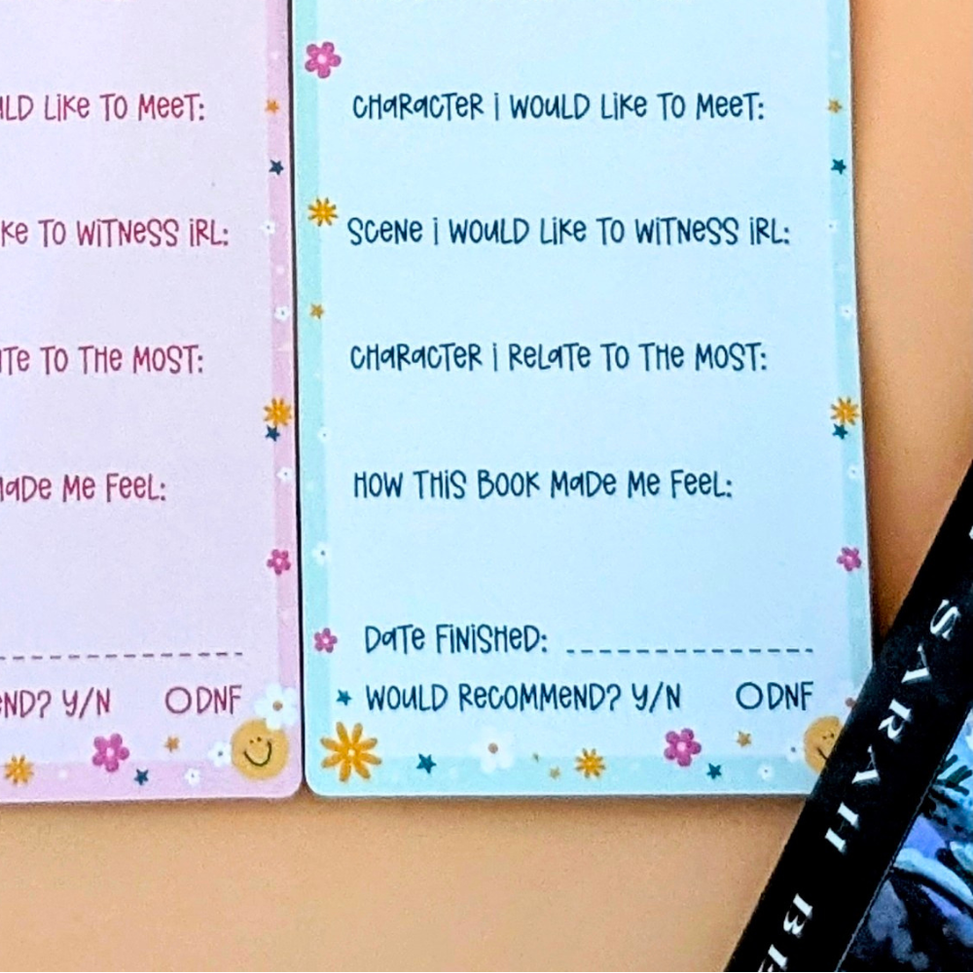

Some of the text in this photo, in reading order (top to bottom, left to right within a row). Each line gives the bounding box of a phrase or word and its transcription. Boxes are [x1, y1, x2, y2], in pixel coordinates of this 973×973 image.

[43, 92, 91, 123] LiKe
[98, 92, 129, 123] TO
[137, 92, 205, 122] MeeT:
[352, 91, 485, 123] CHaRaCTeR
[508, 92, 591, 121] WOuLD
[600, 91, 649, 122] LiKe
[655, 91, 687, 122] TO
[695, 91, 765, 122] MeeT:
[37, 218, 67, 249] TO
[75, 217, 180, 249] WiTNeSS
[188, 217, 229, 248] iRL:
[346, 216, 424, 247] SCeNe
[447, 216, 531, 246] WOuLD
[539, 215, 588, 246] LiKe
[595, 216, 626, 247] TO
[633, 215, 740, 247] WiTNeSS
[748, 215, 791, 246] iRL:
[38, 344, 69, 376] TO
[76, 344, 123, 376] THe
[132, 343, 204, 375] MOST:
[349, 341, 484, 373] CHaRaCTeR
[508, 341, 592, 373] ReLaTe
[599, 341, 631, 373] TO
[637, 341, 685, 373] THe
[694, 341, 768, 373] MOST:
[61, 473, 97, 504] Me
[105, 472, 167, 504] FeeL:
[353, 468, 733, 501] HOW THiS BOOK MaDe Me FeeL:
[364, 622, 548, 656] DaTe FiNiSHeD:
[61, 686, 111, 721] y/N
[365, 680, 682, 715] WOuLD ReCOMMeND? y/N
[824, 598, 960, 854] SARAH
